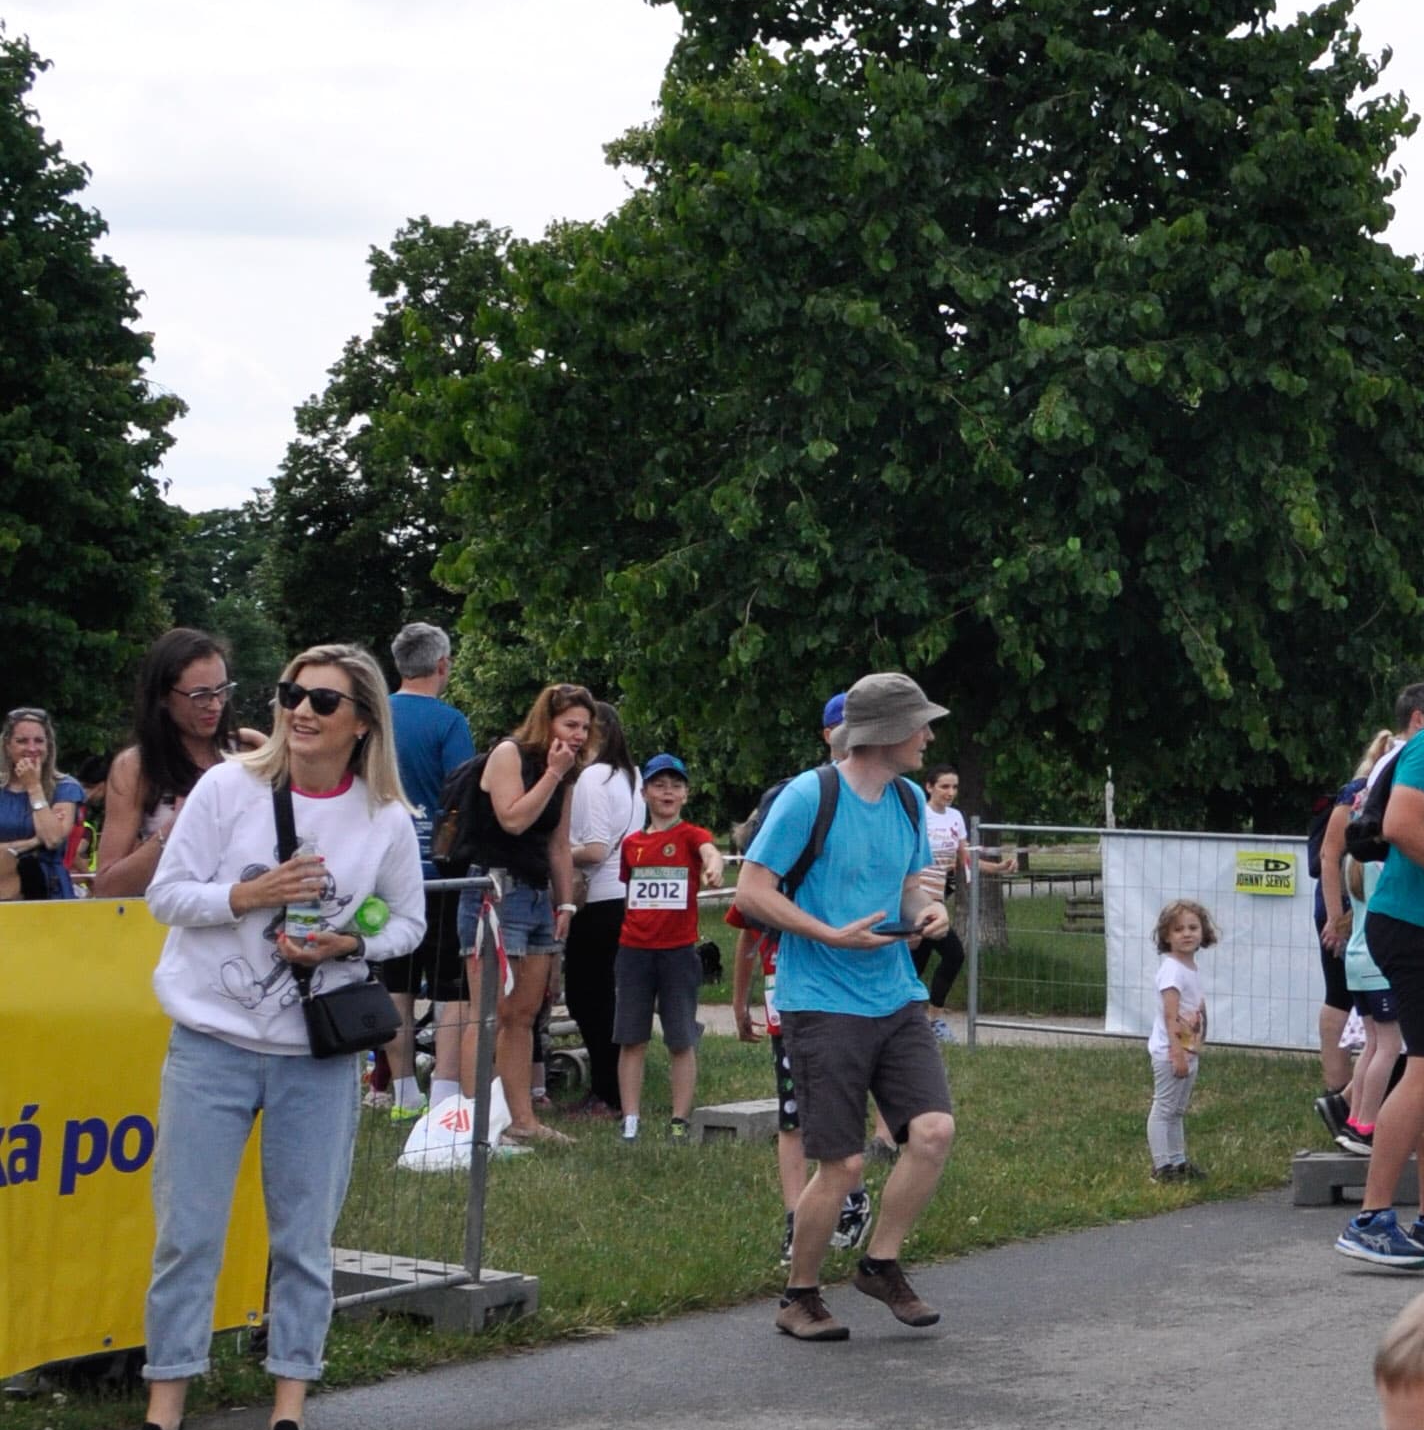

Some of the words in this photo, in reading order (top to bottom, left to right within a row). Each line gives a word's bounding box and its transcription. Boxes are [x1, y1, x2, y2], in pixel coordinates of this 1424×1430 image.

[636, 881, 680, 899] 2012
[0, 1103, 42, 1188] á
[58, 1114, 159, 1196] po
